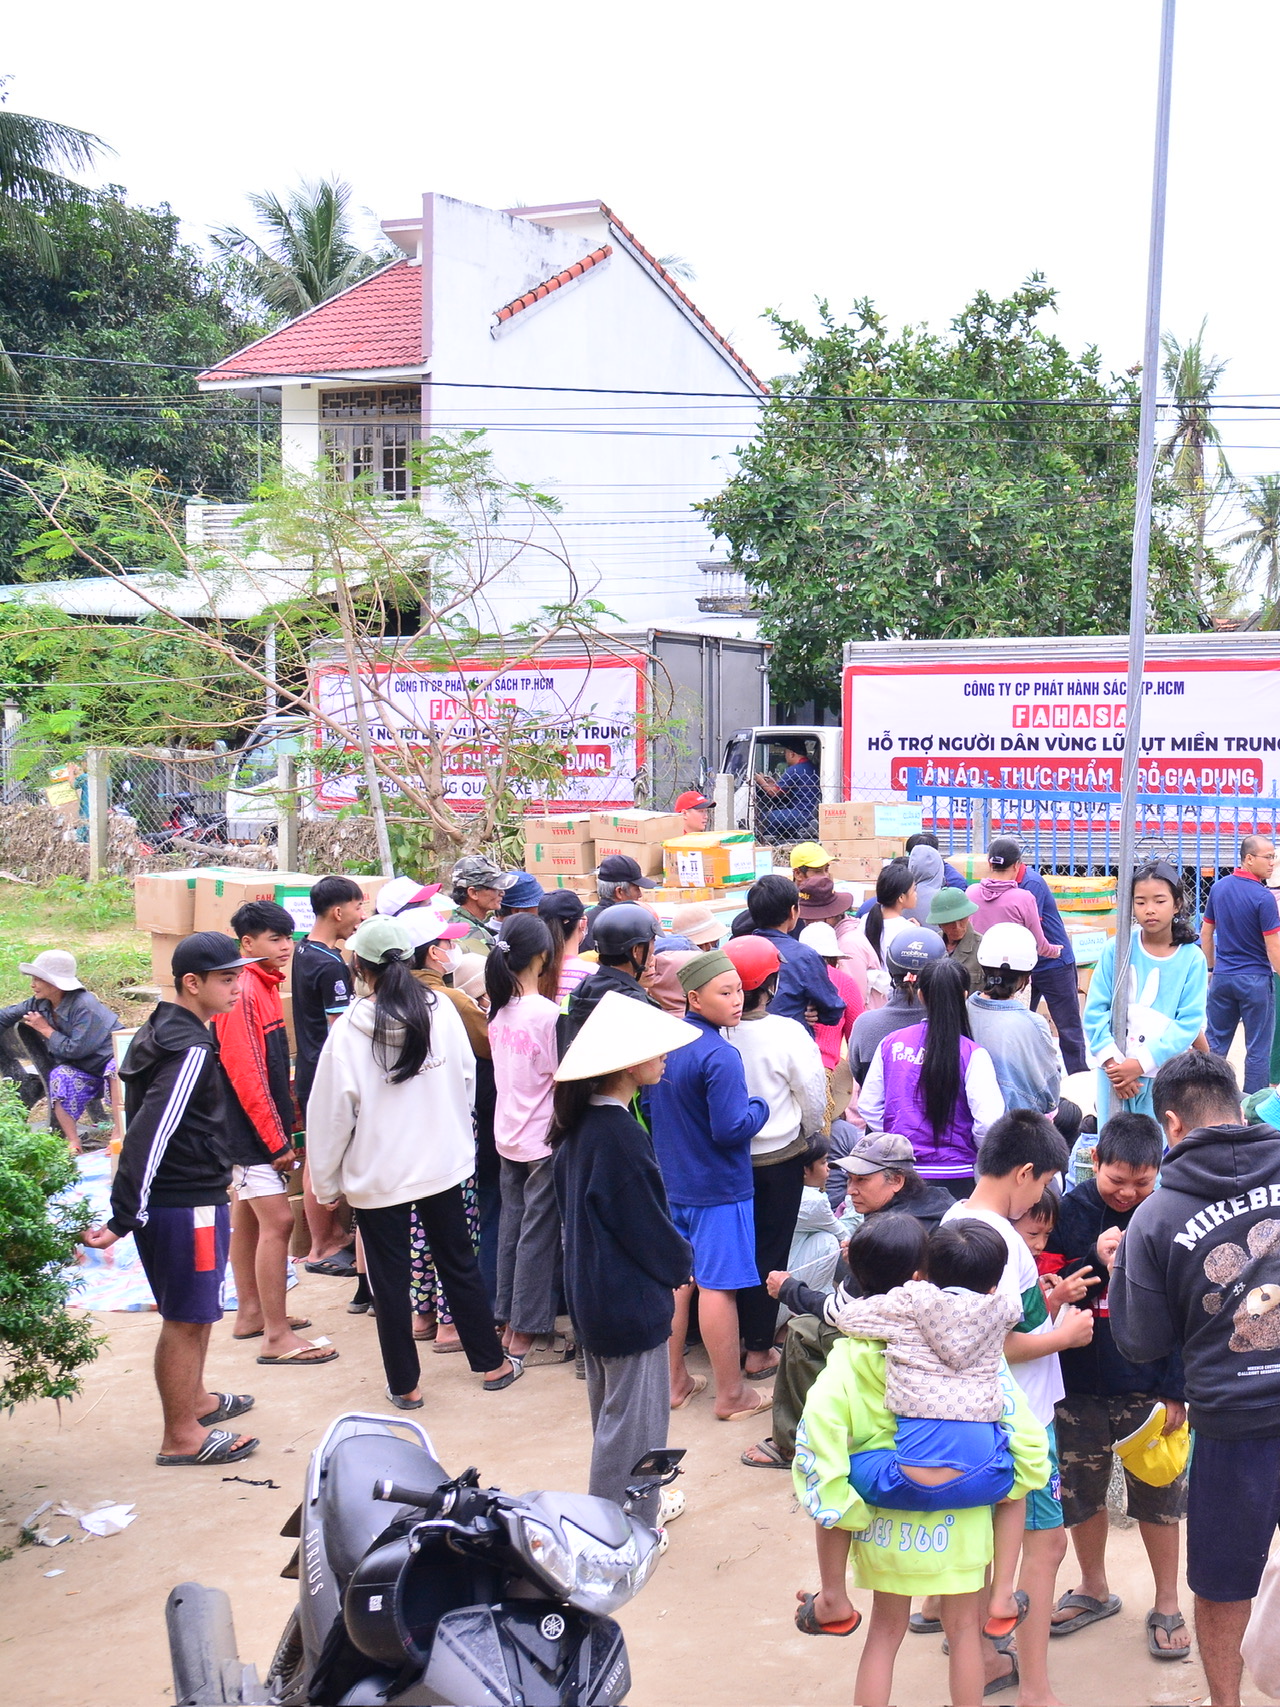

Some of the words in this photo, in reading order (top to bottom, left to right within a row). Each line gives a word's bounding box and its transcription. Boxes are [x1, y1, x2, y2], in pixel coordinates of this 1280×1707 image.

[495, 675, 518, 691] SÁCH
[521, 678, 553, 690] TP.HCM
[964, 680, 995, 696] CÔNG
[999, 683, 1011, 696] TY
[1015, 683, 1030, 696] CP
[1034, 679, 1064, 696] PHÁT
[1067, 679, 1099, 696] HÀNH
[1103, 679, 1127, 696] SÁC
[583, 725, 630, 740] TRUNG
[868, 730, 893, 751] HỖ
[898, 735, 933, 755] TRỢ
[939, 732, 995, 751] NGƯỜI
[1000, 733, 1040, 751] DÂN
[1046, 732, 1097, 752] VÙNG
[1137, 737, 1166, 755] ỤT
[1171, 731, 1219, 752] MIỀN
[566, 752, 606, 774] DỤNG
[953, 762, 981, 786] ÁO
[1000, 764, 1052, 788] THỰC
[1058, 759, 1113, 786] PHẨM
[1165, 768, 1198, 786] GIA
[1201, 767, 1255, 789] DỤNG
[907, 941, 925, 950] 4G
[305, 1528, 324, 1597] SIRIUS
[604, 1660, 625, 1695] SIRIUS
